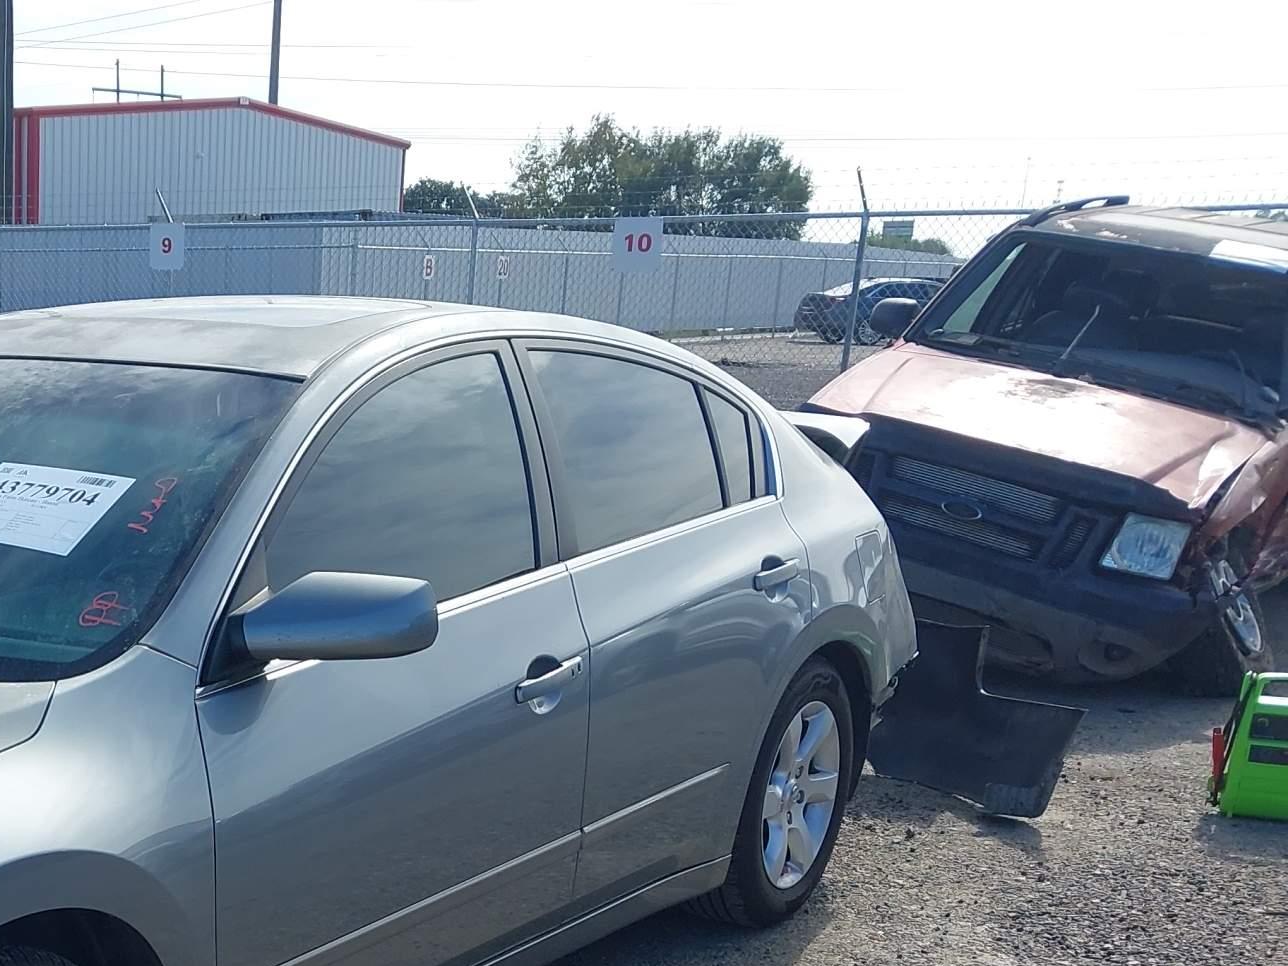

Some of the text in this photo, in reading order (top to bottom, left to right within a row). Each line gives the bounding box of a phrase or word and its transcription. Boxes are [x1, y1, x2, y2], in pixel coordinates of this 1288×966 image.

[162, 237, 172, 254] 9
[624, 233, 652, 253] 10
[425, 258, 434, 277] B
[498, 258, 510, 276] 20
